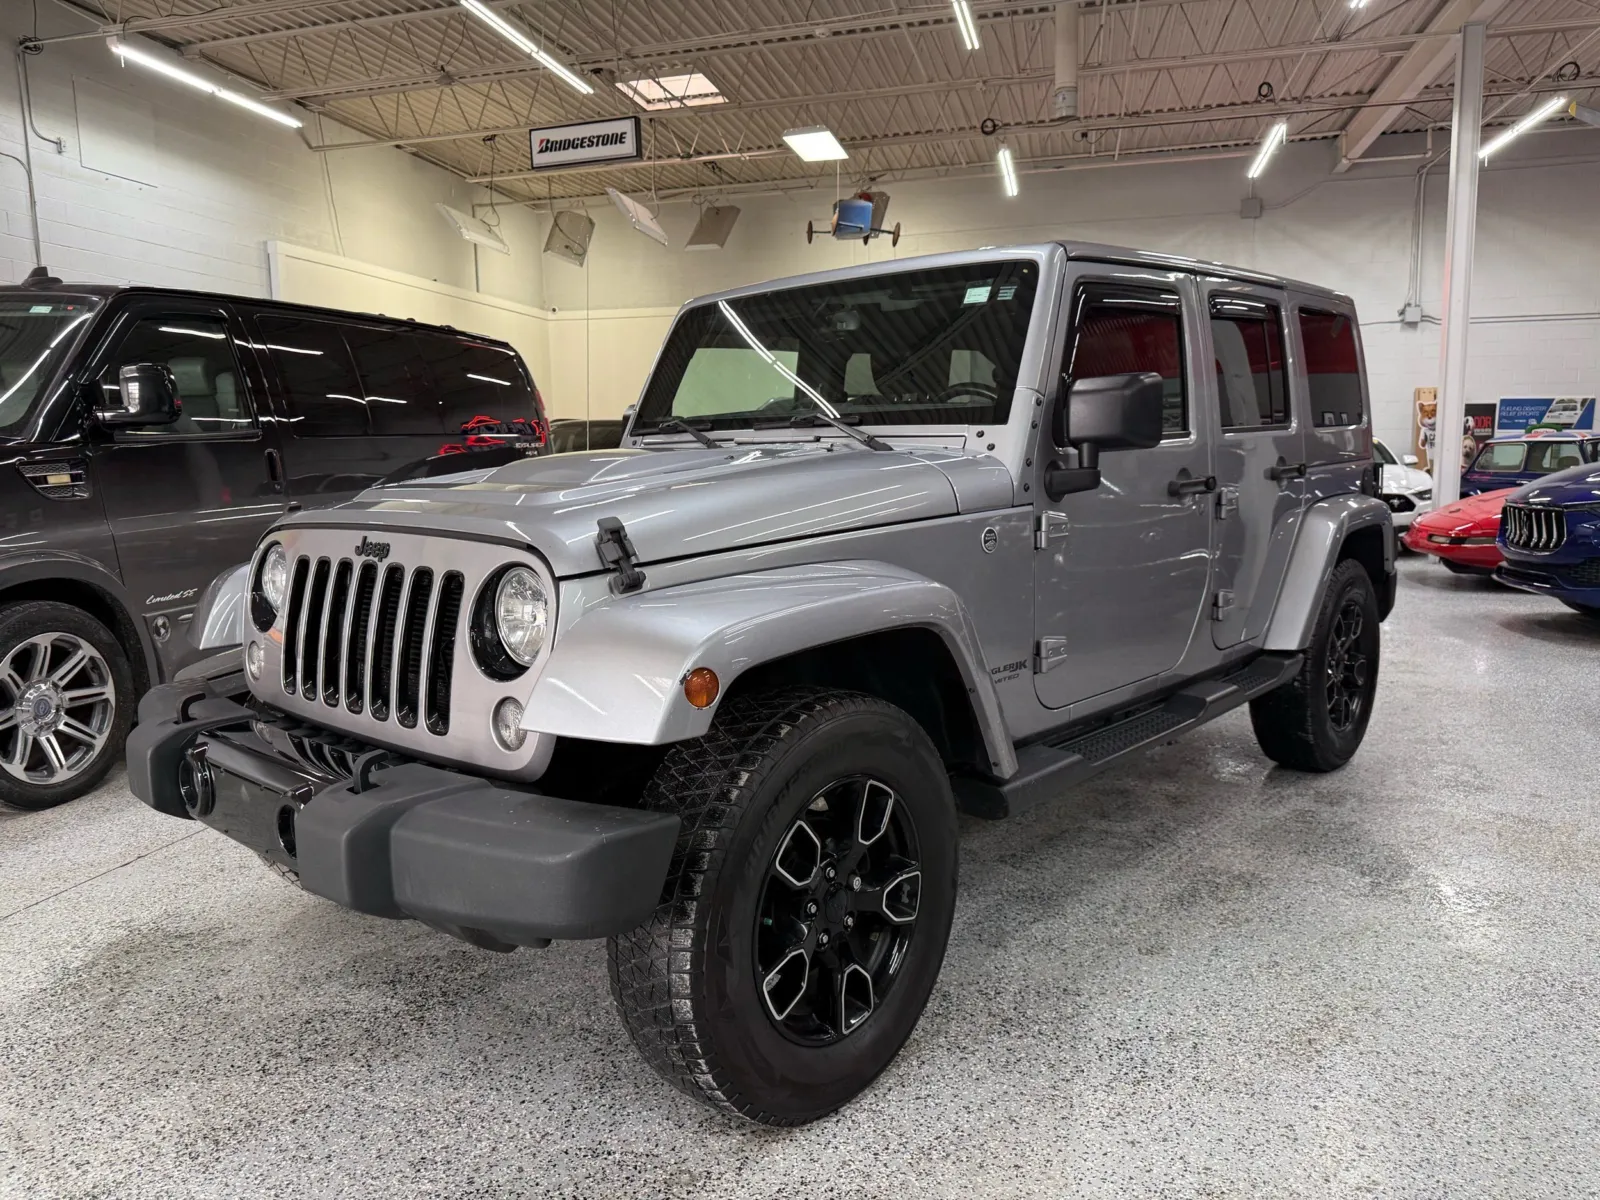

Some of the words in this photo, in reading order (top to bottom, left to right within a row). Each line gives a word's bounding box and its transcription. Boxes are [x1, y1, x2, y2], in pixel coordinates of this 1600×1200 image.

[537, 132, 627, 154] BRIDGESTONE
[355, 536, 390, 562] Jeep
[146, 591, 183, 605] Limited
